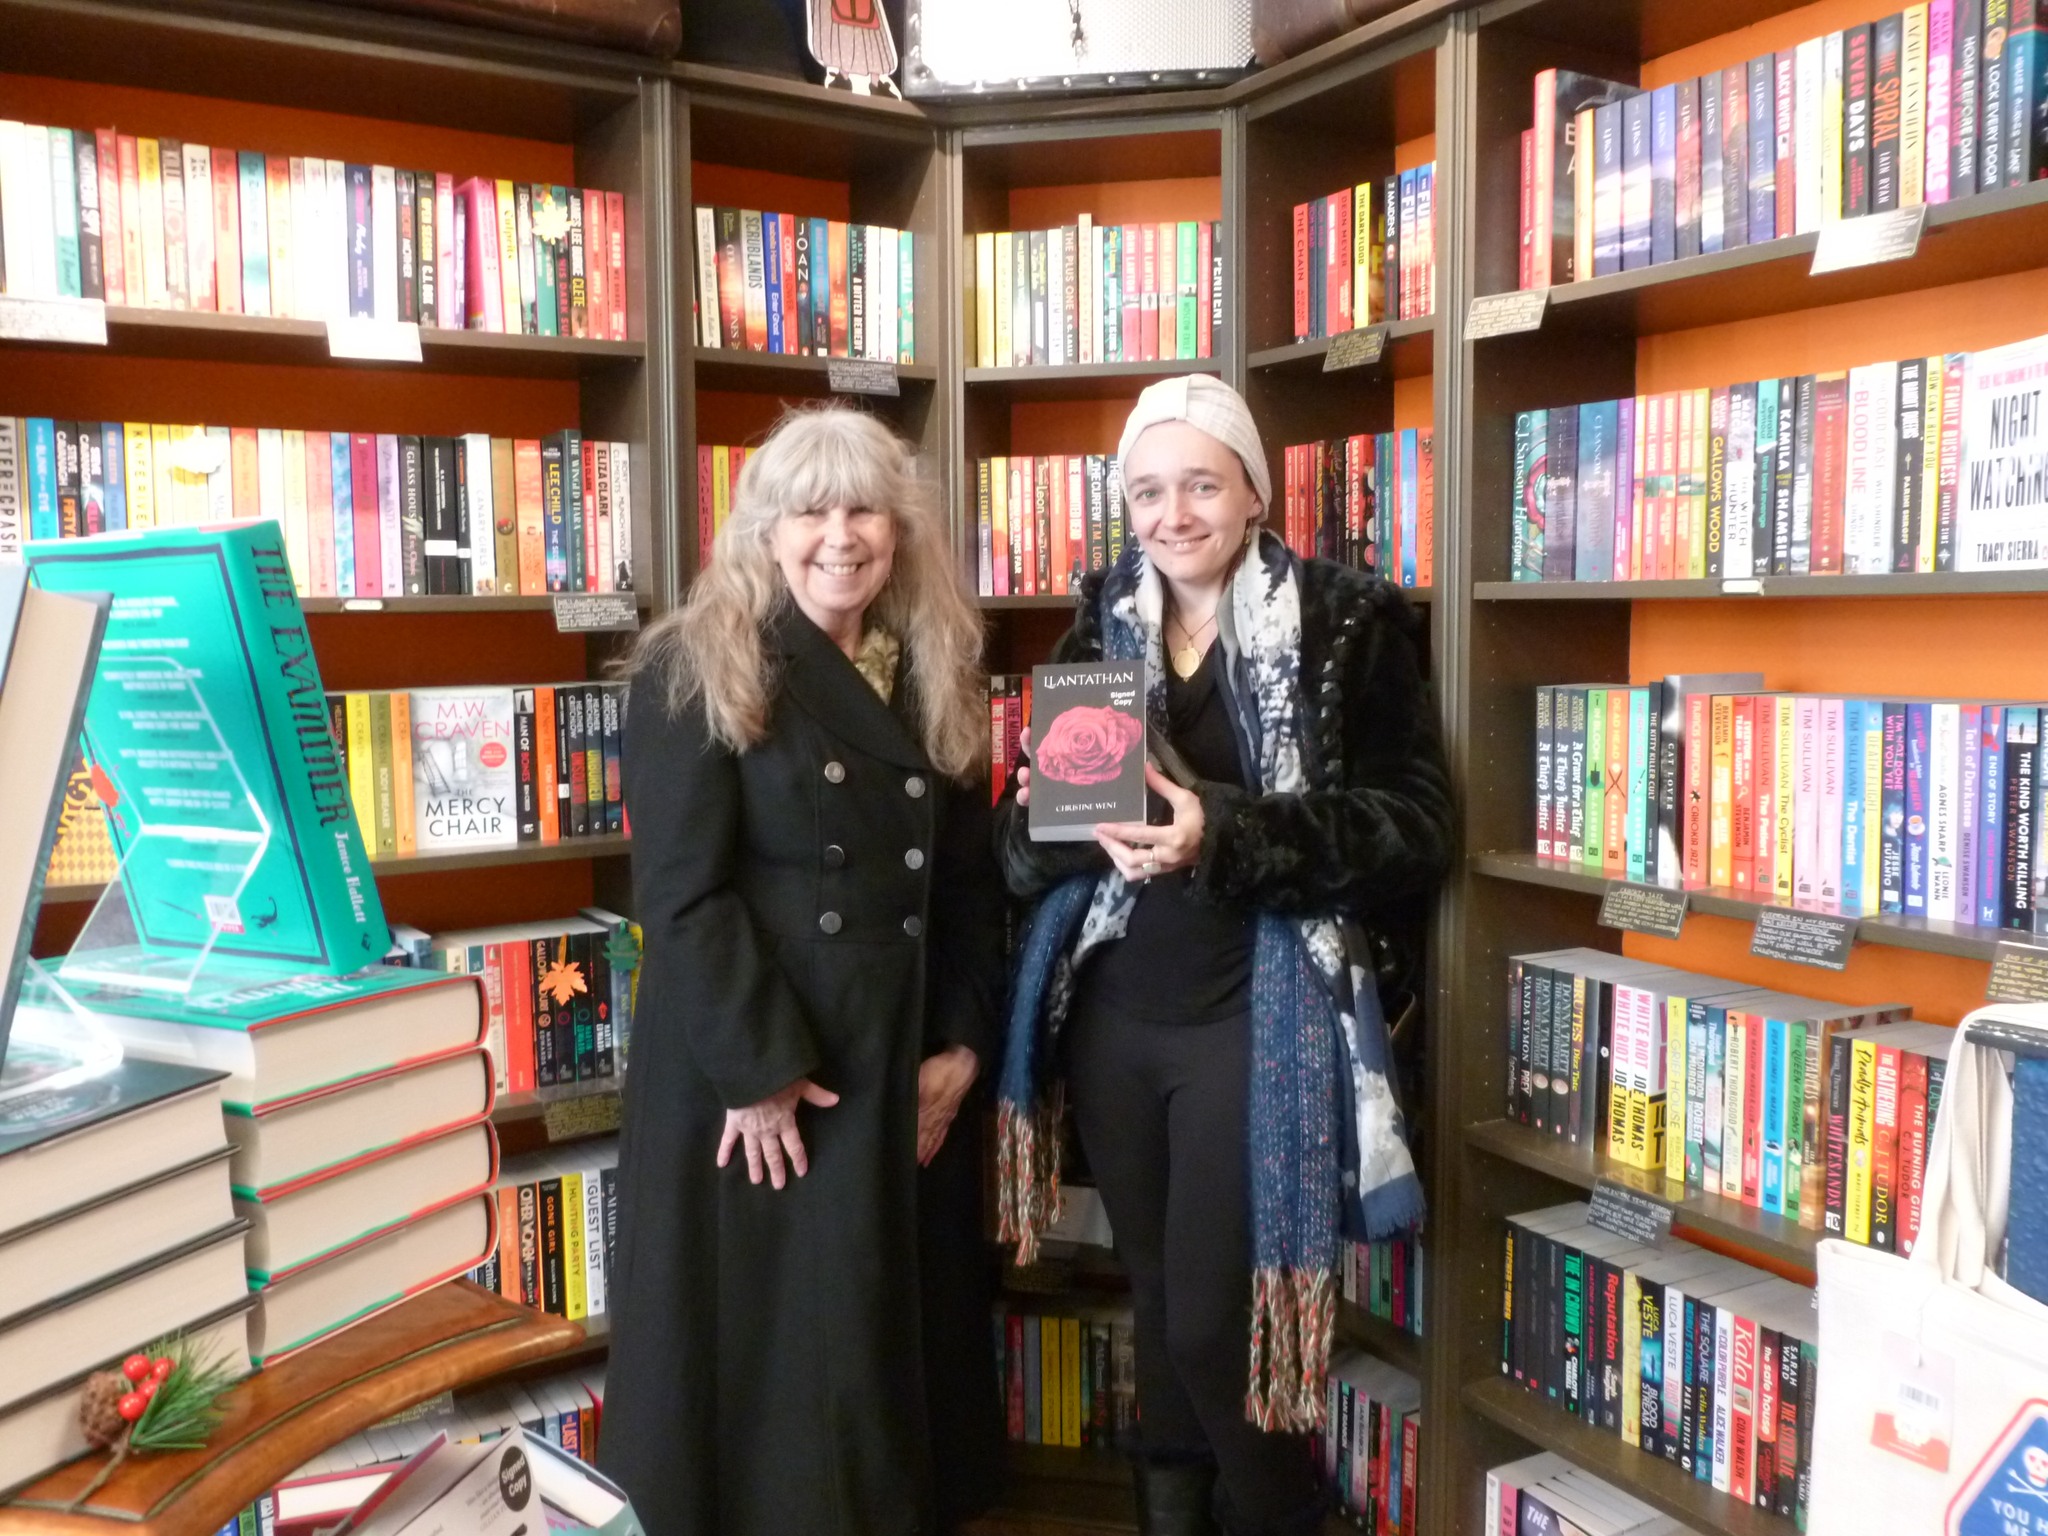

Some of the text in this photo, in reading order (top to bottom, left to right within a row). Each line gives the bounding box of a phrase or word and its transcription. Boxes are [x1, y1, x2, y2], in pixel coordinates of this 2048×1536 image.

[1849, 35, 1866, 151] SEVEN DAYS
[1958, 35, 1975, 178] HOME BEFORE DARK
[1926, 54, 1949, 192] FINAL GIRLS
[1984, 64, 2001, 184] LOCK EVERY DOOR
[421, 197, 434, 261] OPEN SEASON
[570, 196, 581, 226] JAMES
[571, 228, 582, 244] LEE
[1387, 191, 1395, 237] MAIDENS
[746, 217, 762, 288] SCRUBLANDS
[796, 223, 808, 280] JOAN
[1065, 231, 1075, 310] THE PLUS ONE
[573, 278, 584, 306] CLETE
[772, 293, 780, 335] Enter Ghost
[853, 285, 862, 315] BITTER
[854, 317, 863, 351] REMEDY
[1852, 391, 1869, 494] BLOOD LINE
[1989, 390, 2042, 449] NIGHT
[67, 444, 77, 473] STEVE
[597, 450, 608, 517] ELIZA CLARK
[613, 449, 621, 493] CLEMENTS
[1352, 473, 1358, 481] A
[1776, 409, 1792, 558] KAMILA SHAMSIE
[549, 463, 561, 524] LEE CHILD
[1091, 463, 1102, 521] THE CURFEW
[1110, 460, 1120, 518] THE MOTHER
[1709, 437, 1723, 552] GALLOWS WOOD
[251, 542, 351, 828] THE EXAMINER
[1044, 672, 1134, 689] LLANTATHAN
[1110, 690, 1135, 699] Signed
[1114, 698, 1133, 706] Copy
[414, 720, 510, 740] CRAVEN
[586, 693, 594, 736] CRITCHLOW
[592, 698, 600, 731] HEATHER
[992, 704, 1004, 764] THE TORMENTS
[1649, 729, 1657, 751] KITTY
[1691, 700, 1702, 786] FRANCIS SPUFFORD
[520, 716, 530, 781] MAN OF BONES
[588, 750, 602, 801] UNBURIED
[1648, 753, 1656, 779] KILLER
[1780, 706, 1791, 789] TIM SULLIVAN
[1848, 710, 1860, 796] TIM SULLIVAN
[1885, 715, 1894, 790] WITH YOU YET
[379, 767, 390, 828] BODY BREAKER
[425, 796, 505, 817] MERCY
[545, 764, 554, 814] TOM CREWE
[1056, 802, 1117, 813] CHRISTINE WENT
[1648, 781, 1656, 800] CULT
[1666, 772, 1674, 810] LOVER
[1987, 756, 1997, 823] END OF STORY
[429, 817, 502, 837] CHAIR
[1690, 806, 1700, 868] CAHOKIA JAZZ
[1938, 785, 1947, 852] AGNES SHARP
[2016, 752, 2031, 908] THE KIND WORTH KILLING
[333, 831, 366, 923] Janice Hallett
[1884, 842, 1892, 886] SUTANTO
[596, 1024, 604, 1052] EDWARDS
[603, 1024, 611, 1048] MARTIN
[1522, 976, 1531, 1062] VANDA SYMON
[1560, 983, 1572, 1076] DONNA TARTT
[1572, 978, 1584, 1042] BRUTES
[1635, 994, 1651, 1069] WHITE RIOT
[1520, 1069, 1530, 1095] PREY
[1631, 1074, 1646, 1151] JOE THOMAS
[1827, 1114, 1843, 1207] WHITESANDS
[1910, 1104, 1923, 1231] THE BURNING GIRLS
[520, 1188, 535, 1262] OTHER WOMEN
[570, 1188, 580, 1276] HUNTING PARTY
[588, 1185, 600, 1270] GUEST LIST
[1603, 1273, 1619, 1360] Reputation
[1642, 1295, 1653, 1339] VESTE
[1668, 1296, 1677, 1370] LUCA VESTE
[1699, 1312, 1710, 1383] THE SQUARE
[1734, 1324, 1753, 1383] Kala
[1782, 1346, 1790, 1381] WARD
[1789, 1346, 1798, 1386] SARAH
[1641, 1382, 1650, 1428] STREAM
[1649, 1388, 1658, 1429] BLOOD
[501, 1454, 525, 1484] Signed
[508, 1475, 527, 1497] Copy
[1527, 1506, 1549, 1530] THE
[1990, 1497, 2030, 1525] YOU
